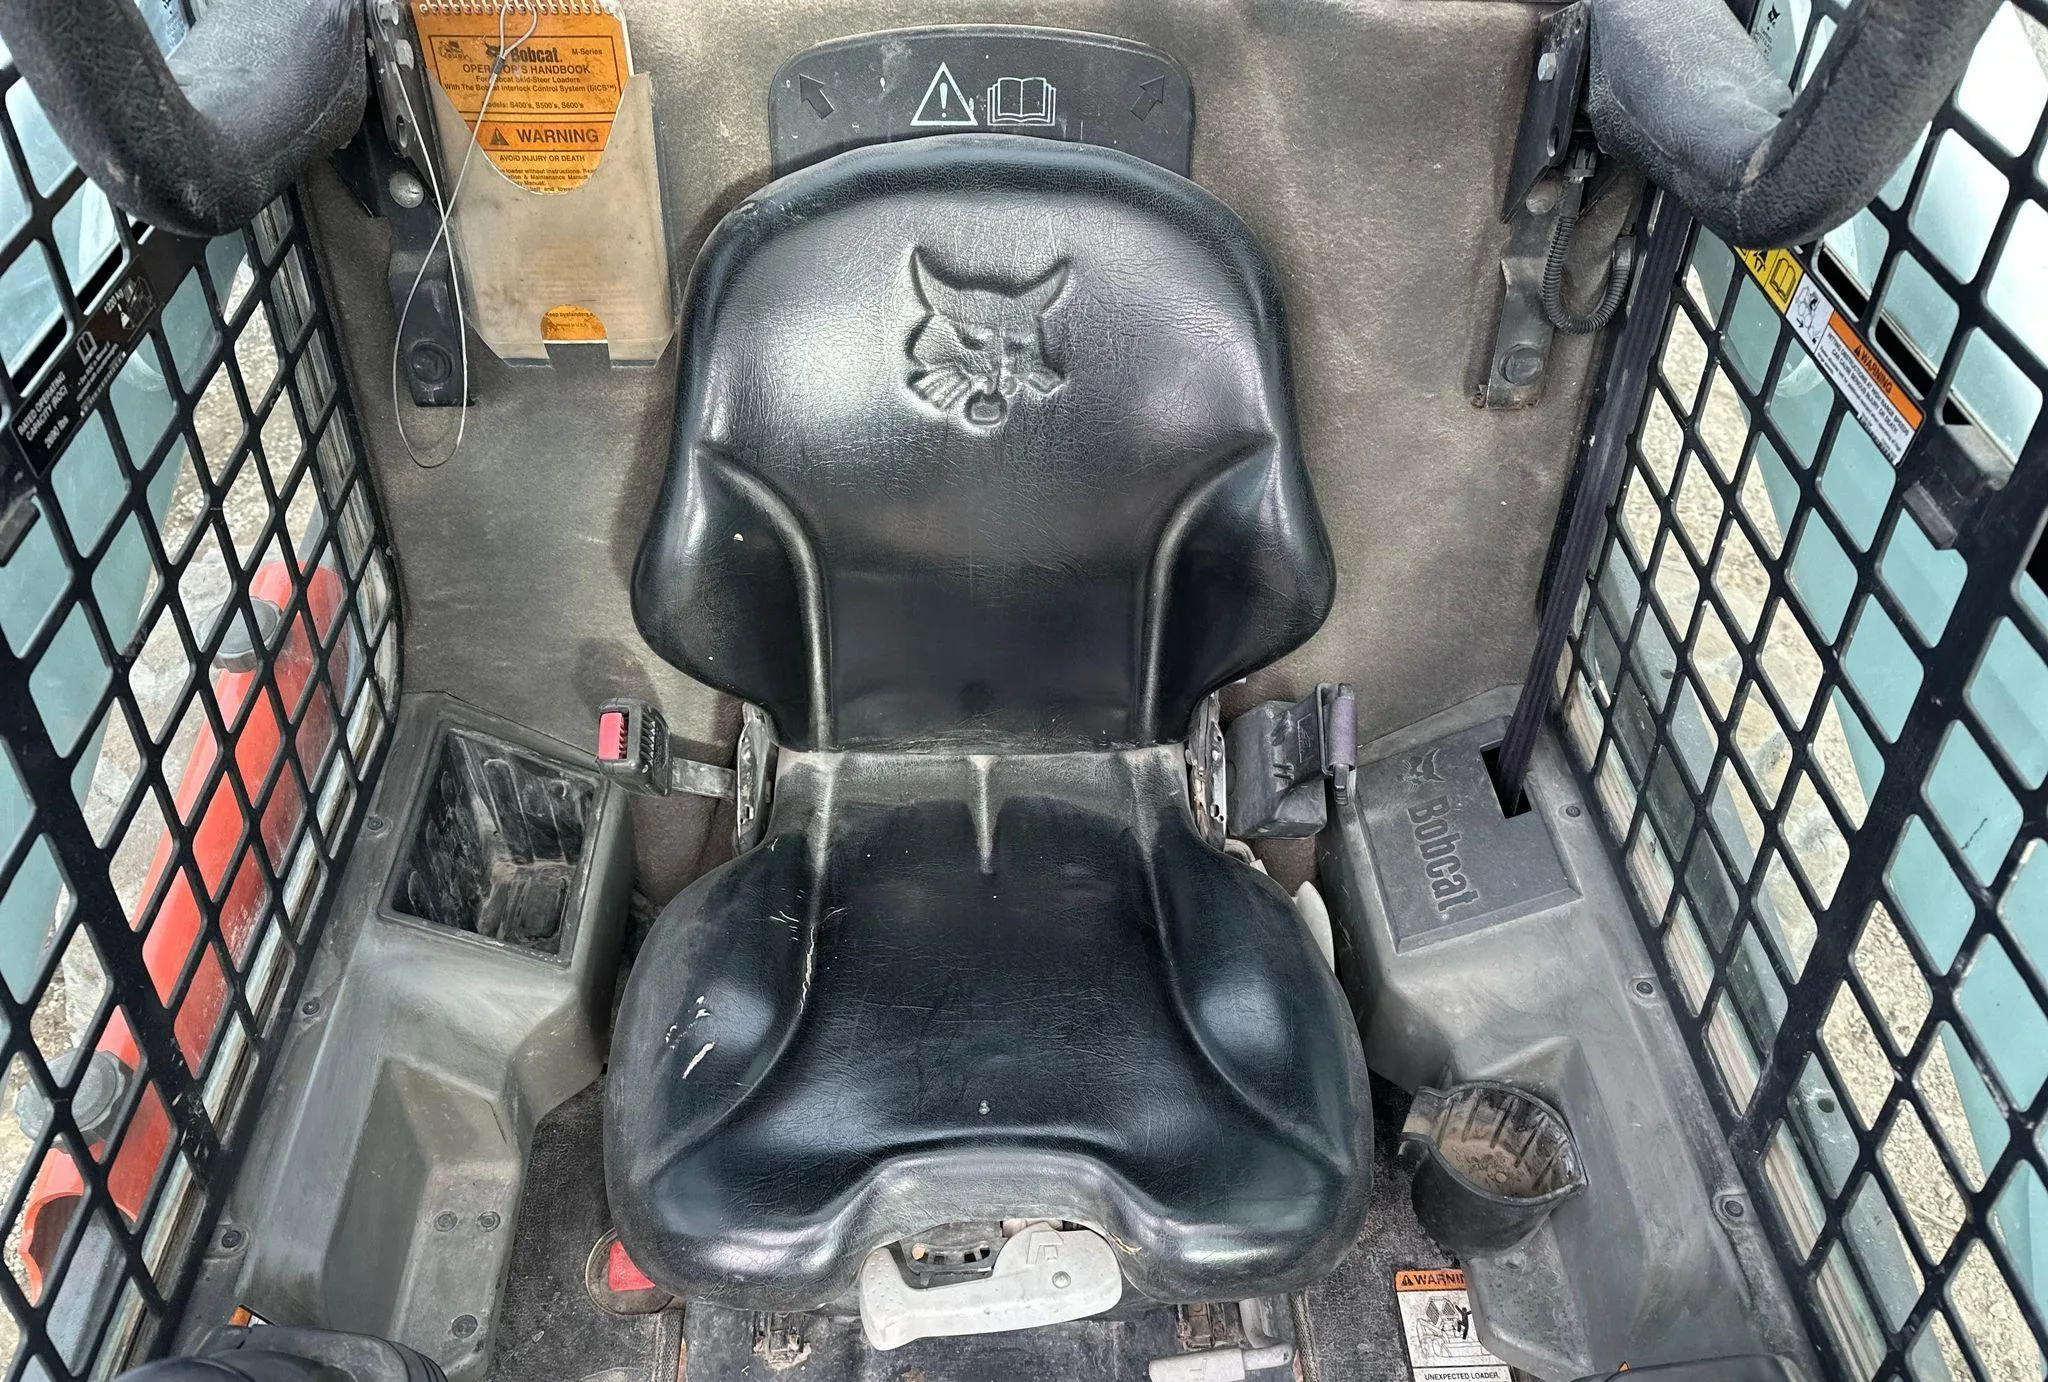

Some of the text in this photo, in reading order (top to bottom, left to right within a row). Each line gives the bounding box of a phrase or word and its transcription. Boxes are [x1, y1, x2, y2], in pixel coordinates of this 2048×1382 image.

[530, 65, 591, 74] HANDBOOK
[559, 85, 586, 93] System
[516, 129, 599, 143] WARNING
[1860, 353, 1893, 394] WARNING
[17, 371, 66, 436] RATED OPERATING
[25, 404, 53, 442] CAPACITY
[1406, 795, 1480, 913] Bobcat
[1424, 1372, 1470, 1381] UNEXPECTED
